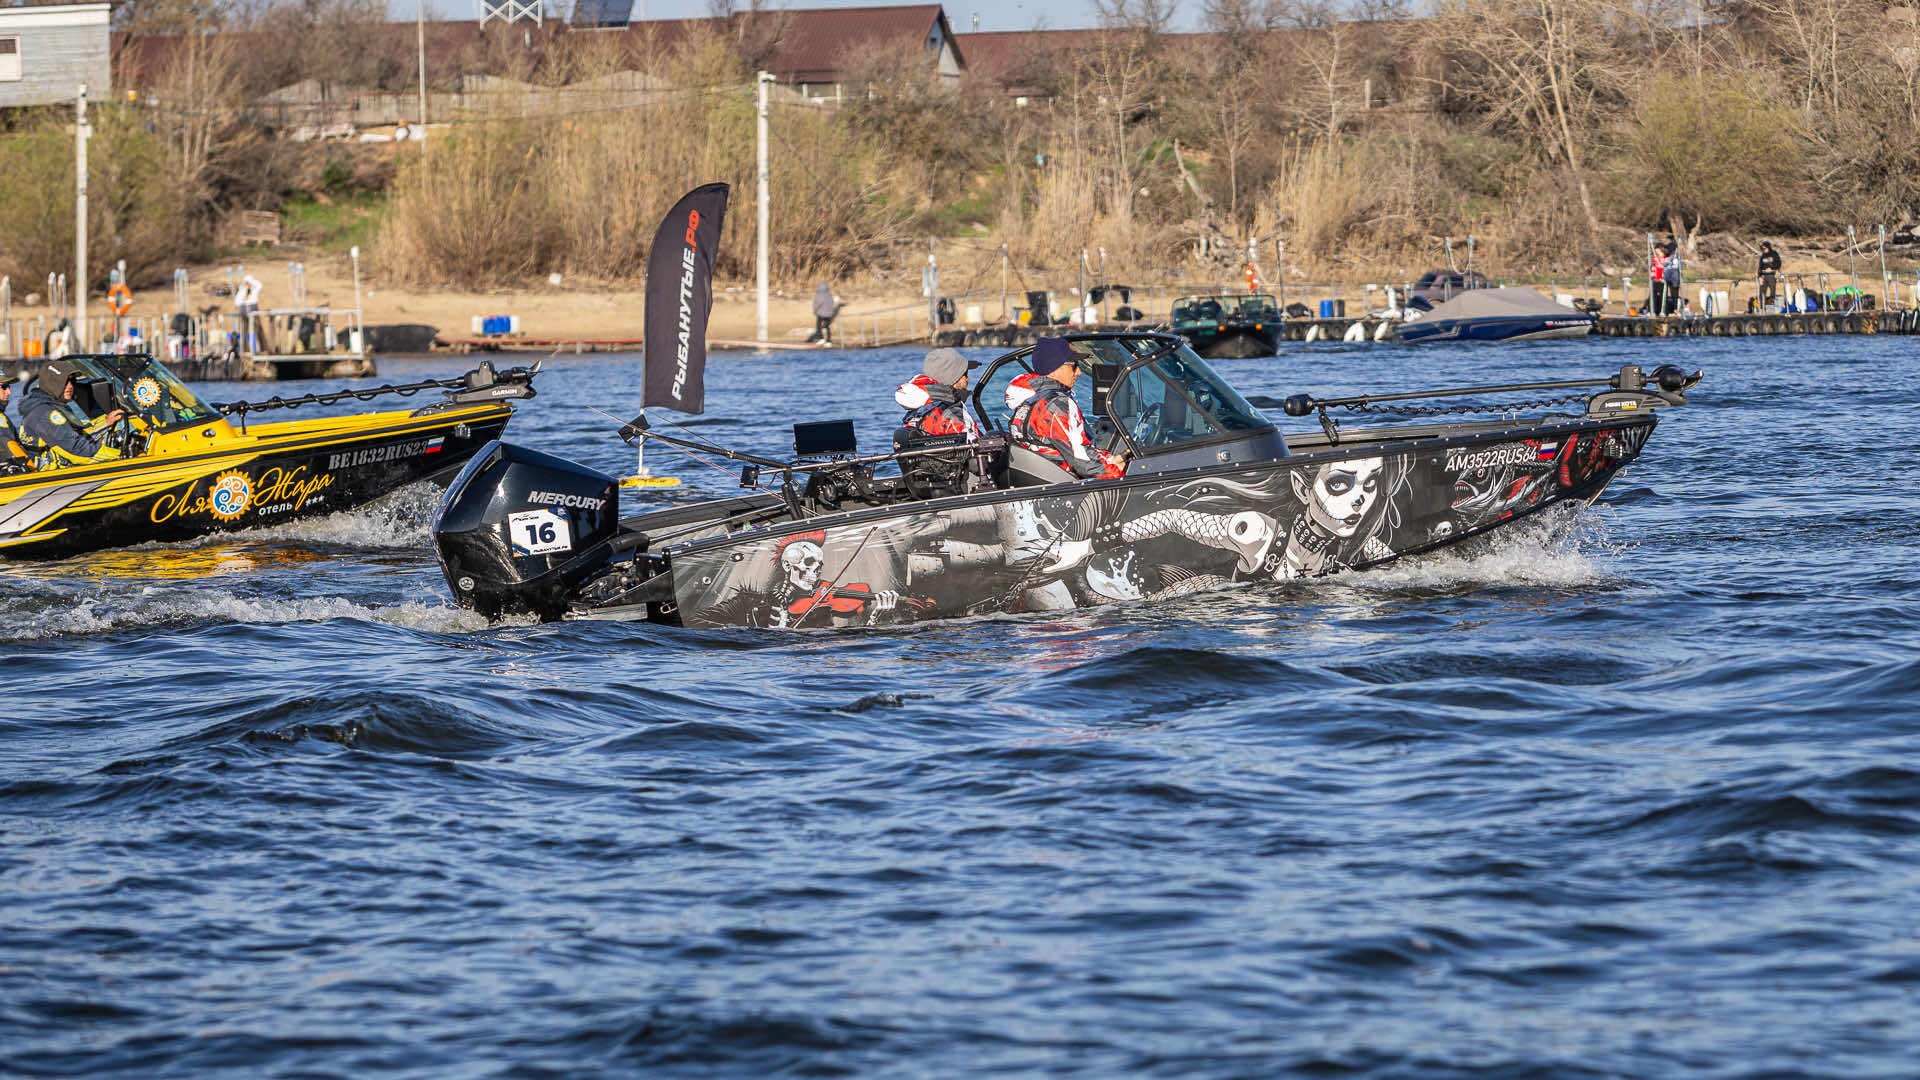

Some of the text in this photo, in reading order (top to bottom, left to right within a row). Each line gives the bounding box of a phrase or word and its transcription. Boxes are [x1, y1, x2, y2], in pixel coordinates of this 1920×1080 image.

[672, 209, 700, 400] РЫБАНУТЫЕ.РФ
[328, 440, 428, 470] BE1832RUS23
[1445, 446, 1538, 472] AM3522RUS64
[254, 465, 335, 511] Жара
[527, 490, 604, 510] MERCURY
[525, 522, 556, 545] 16
